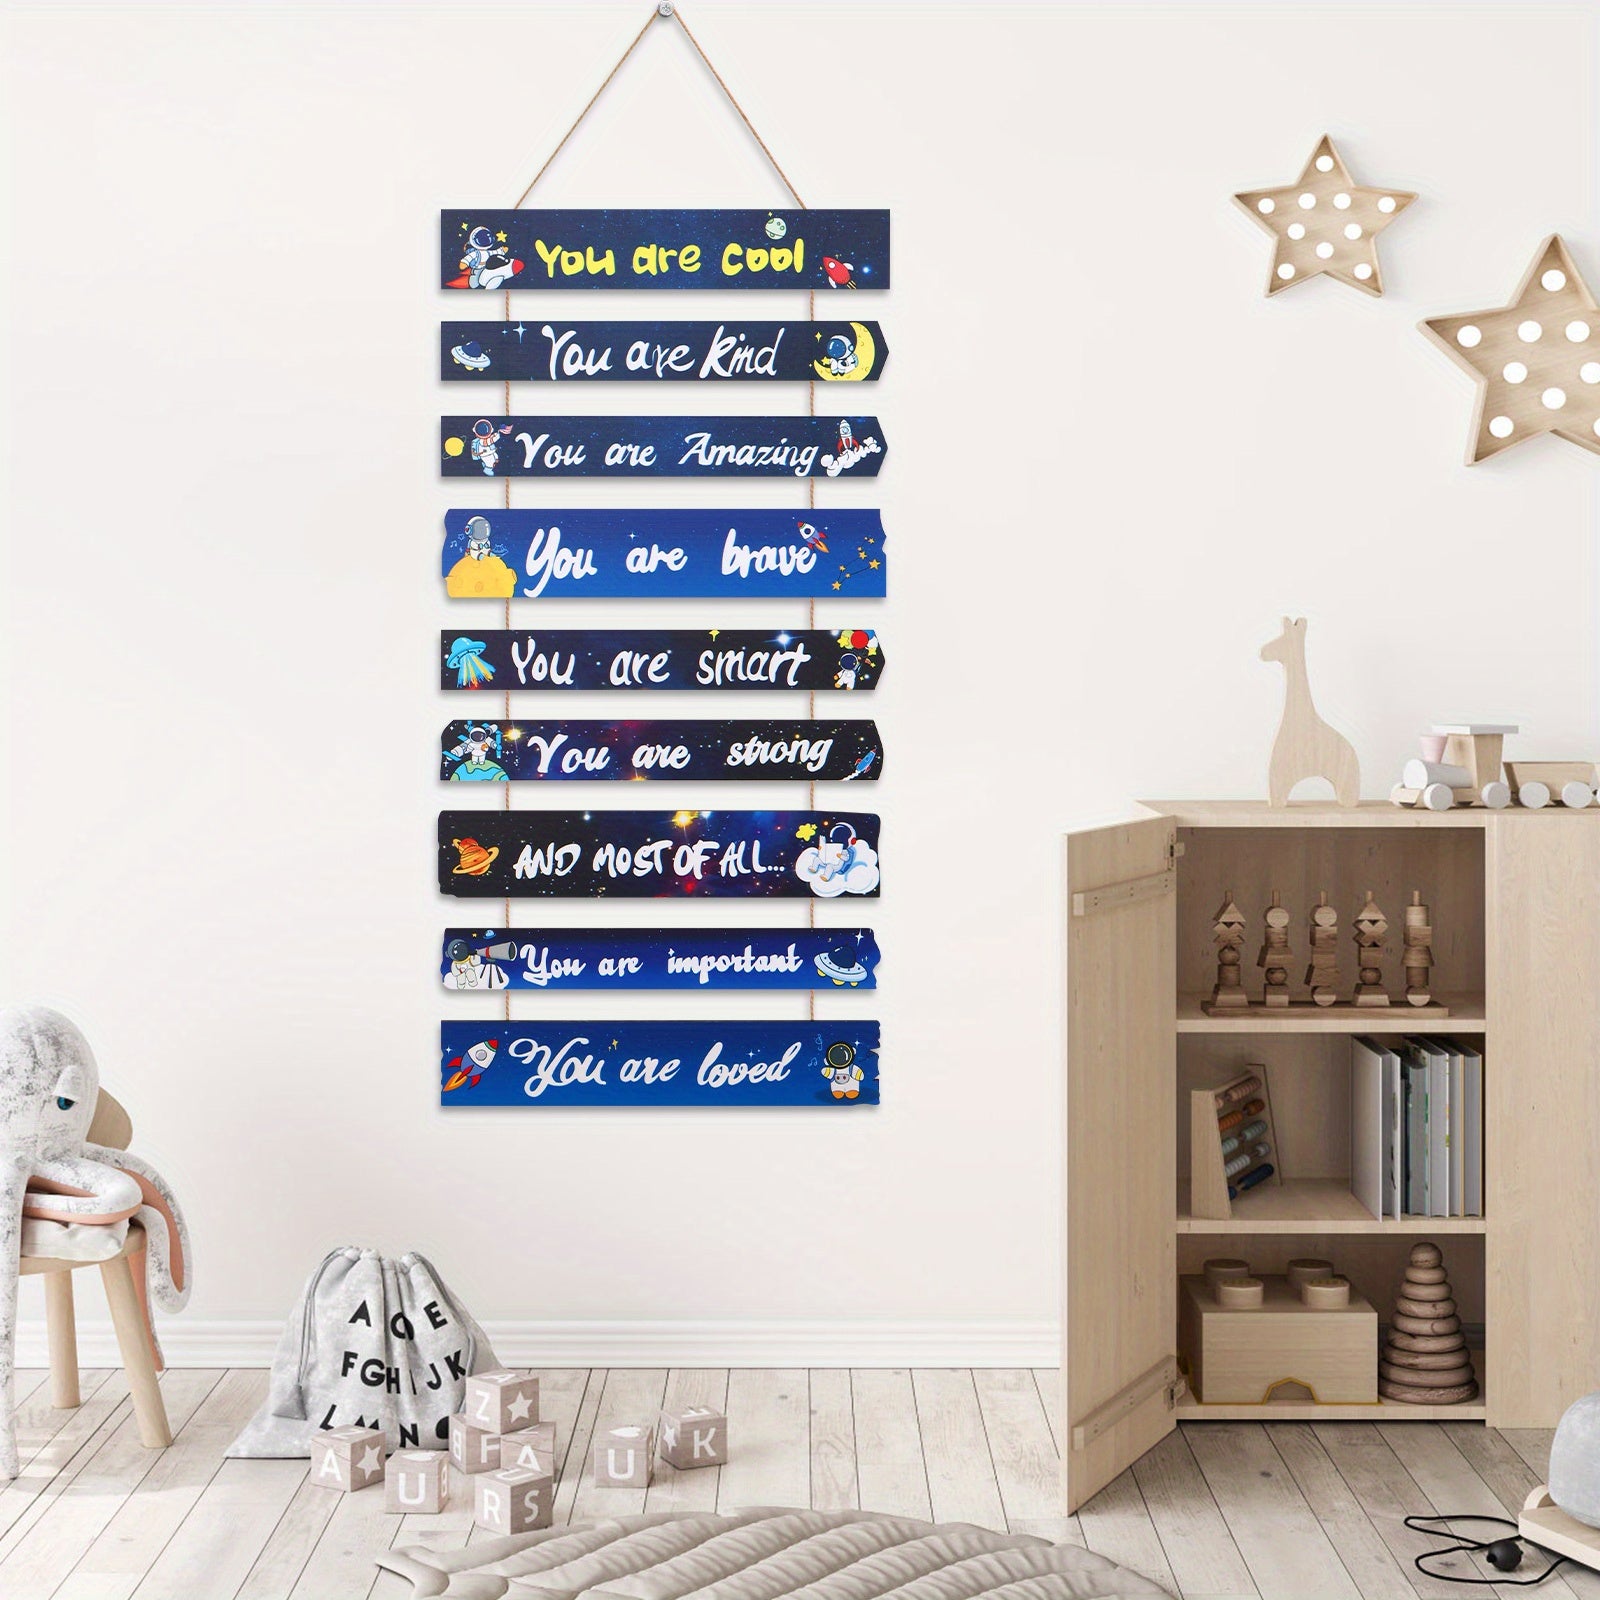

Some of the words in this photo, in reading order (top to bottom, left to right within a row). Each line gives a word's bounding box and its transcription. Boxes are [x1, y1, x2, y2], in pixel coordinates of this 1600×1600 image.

[535, 240, 615, 278] You
[633, 244, 701, 275] are
[722, 238, 804, 275] cool
[541, 325, 613, 381] You
[626, 341, 695, 378] are
[515, 433, 586, 468] You
[605, 444, 656, 466] are
[677, 433, 820, 477] Amazing
[523, 527, 598, 598] You
[626, 544, 687, 573] are
[722, 528, 816, 578] brave
[512, 639, 574, 684] You
[610, 650, 671, 685] are
[696, 642, 812, 687] smart
[528, 734, 610, 773] You
[632, 744, 690, 769] are
[727, 736, 833, 772] strong
[513, 843, 581, 879] AND
[593, 840, 676, 877] MOST
[676, 839, 722, 879] OF
[719, 840, 784, 877] ALL...
[519, 943, 587, 985] You
[598, 957, 643, 976] are
[668, 944, 803, 983] important
[509, 1038, 606, 1096] You
[620, 1058, 680, 1083] are
[697, 1042, 801, 1087] loved
[348, 1300, 372, 1327] A
[424, 1301, 448, 1329] E
[693, 1427, 716, 1458] K
[319, 1448, 343, 1482] A
[608, 1448, 635, 1479] U
[398, 1472, 426, 1505] U
[483, 1488, 501, 1524] R
[524, 1489, 540, 1524] S
